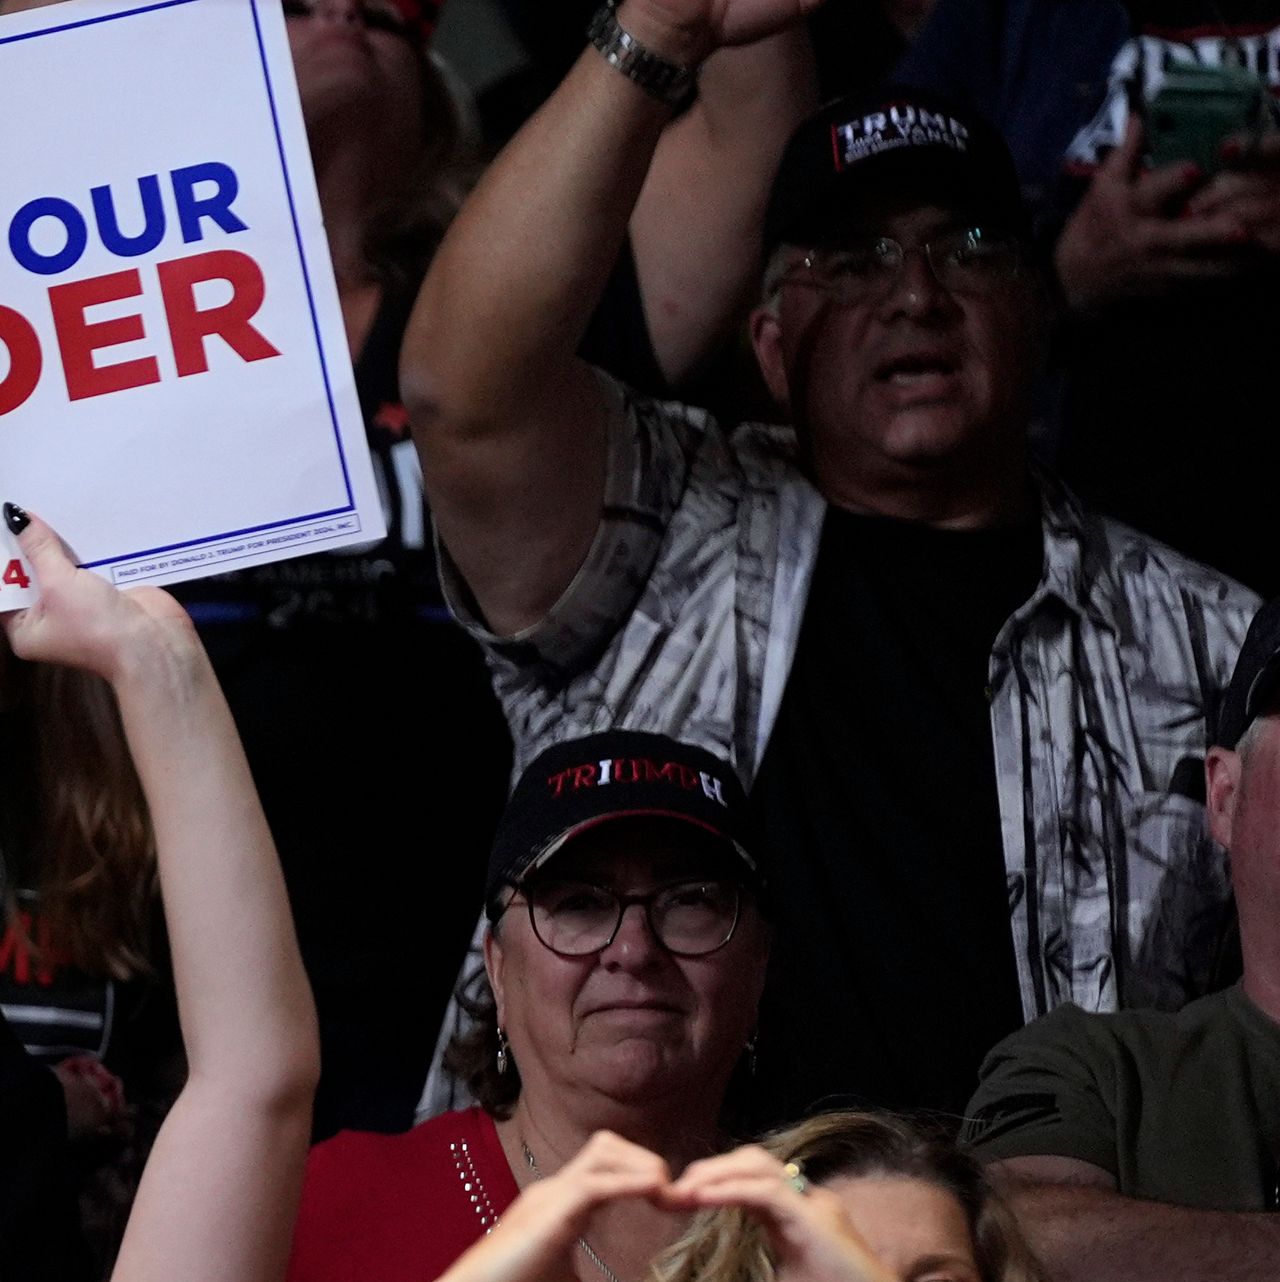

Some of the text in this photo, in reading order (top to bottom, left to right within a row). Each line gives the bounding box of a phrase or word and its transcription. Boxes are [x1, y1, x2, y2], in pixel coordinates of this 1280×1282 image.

[7, 161, 249, 276] OUR
[118, 568, 138, 578] PAID
[140, 564, 157, 573] FOR
[159, 561, 169, 569] BY
[171, 553, 207, 567] DONALD
[217, 545, 246, 556] TRUMP
[247, 541, 264, 550] FOR
[265, 530, 312, 546] PRESIDENT
[546, 756, 729, 808] TRIUMPH
